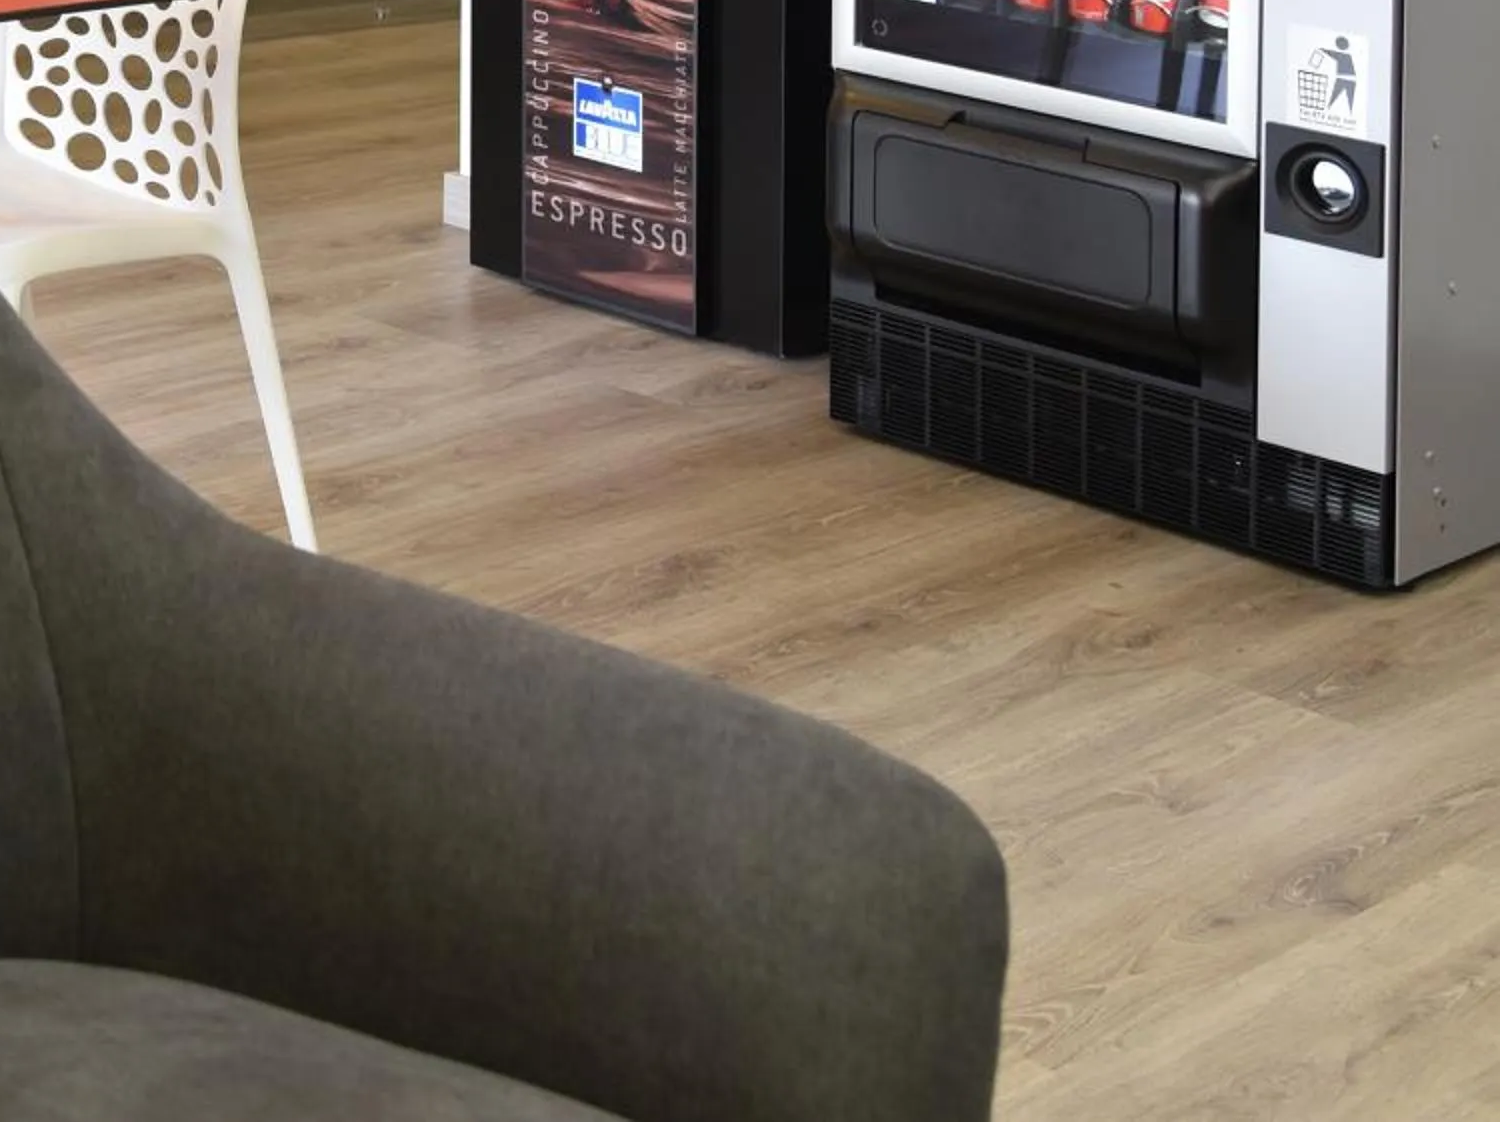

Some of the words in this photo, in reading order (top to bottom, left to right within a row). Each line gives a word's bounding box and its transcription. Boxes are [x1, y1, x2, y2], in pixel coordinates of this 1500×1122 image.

[531, 9, 550, 186] CAPPUCCINO
[531, 189, 688, 257] ESPRESSO
[674, 162, 688, 224] LATTE
